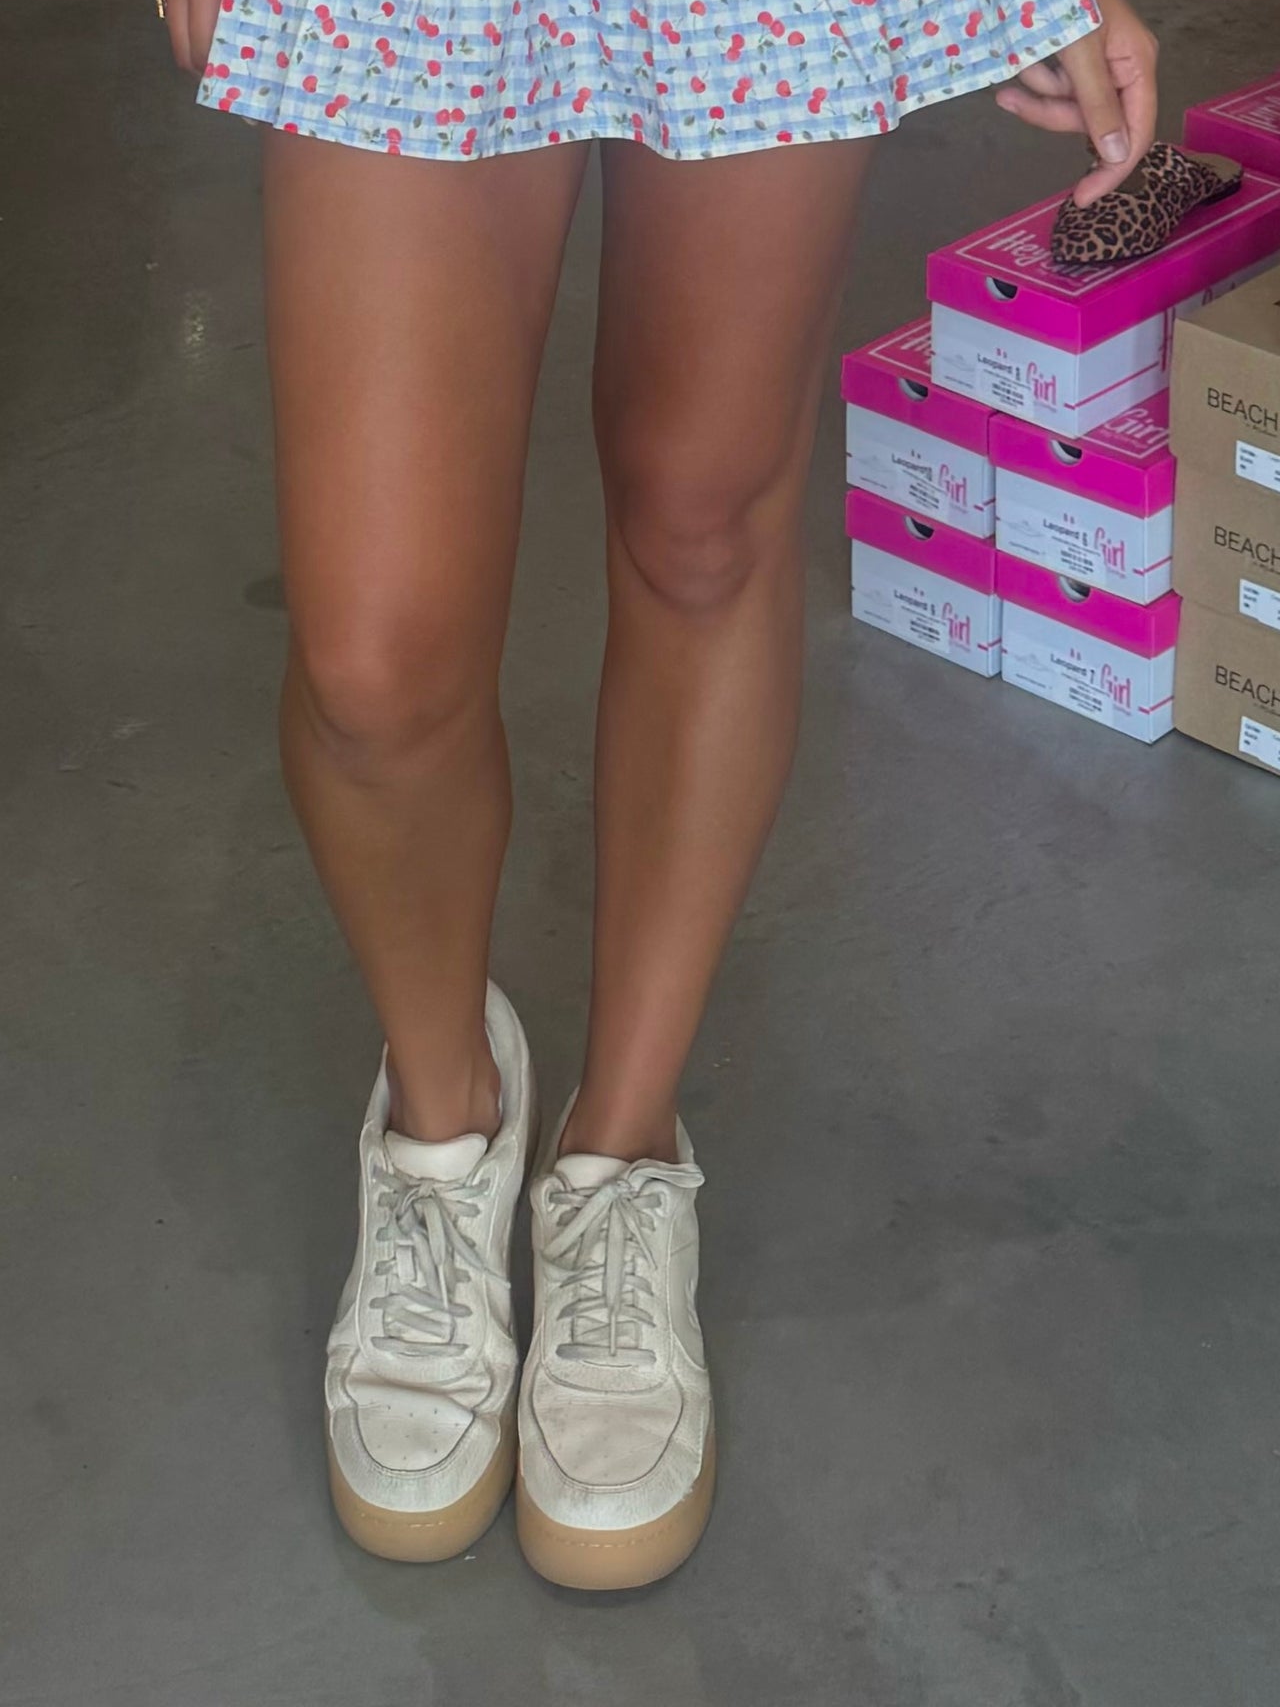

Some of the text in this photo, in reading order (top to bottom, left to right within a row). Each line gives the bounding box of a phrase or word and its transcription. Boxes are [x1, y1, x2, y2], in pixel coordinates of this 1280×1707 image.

[987, 229, 1053, 267] Hey
[1026, 361, 1057, 407] Girl
[1104, 408, 1170, 445] Girl
[1206, 387, 1279, 431] BEACH
[938, 464, 968, 506] Girl
[1094, 527, 1125, 572] Girl
[942, 602, 970, 644] Girl
[1100, 663, 1131, 709] Girl
